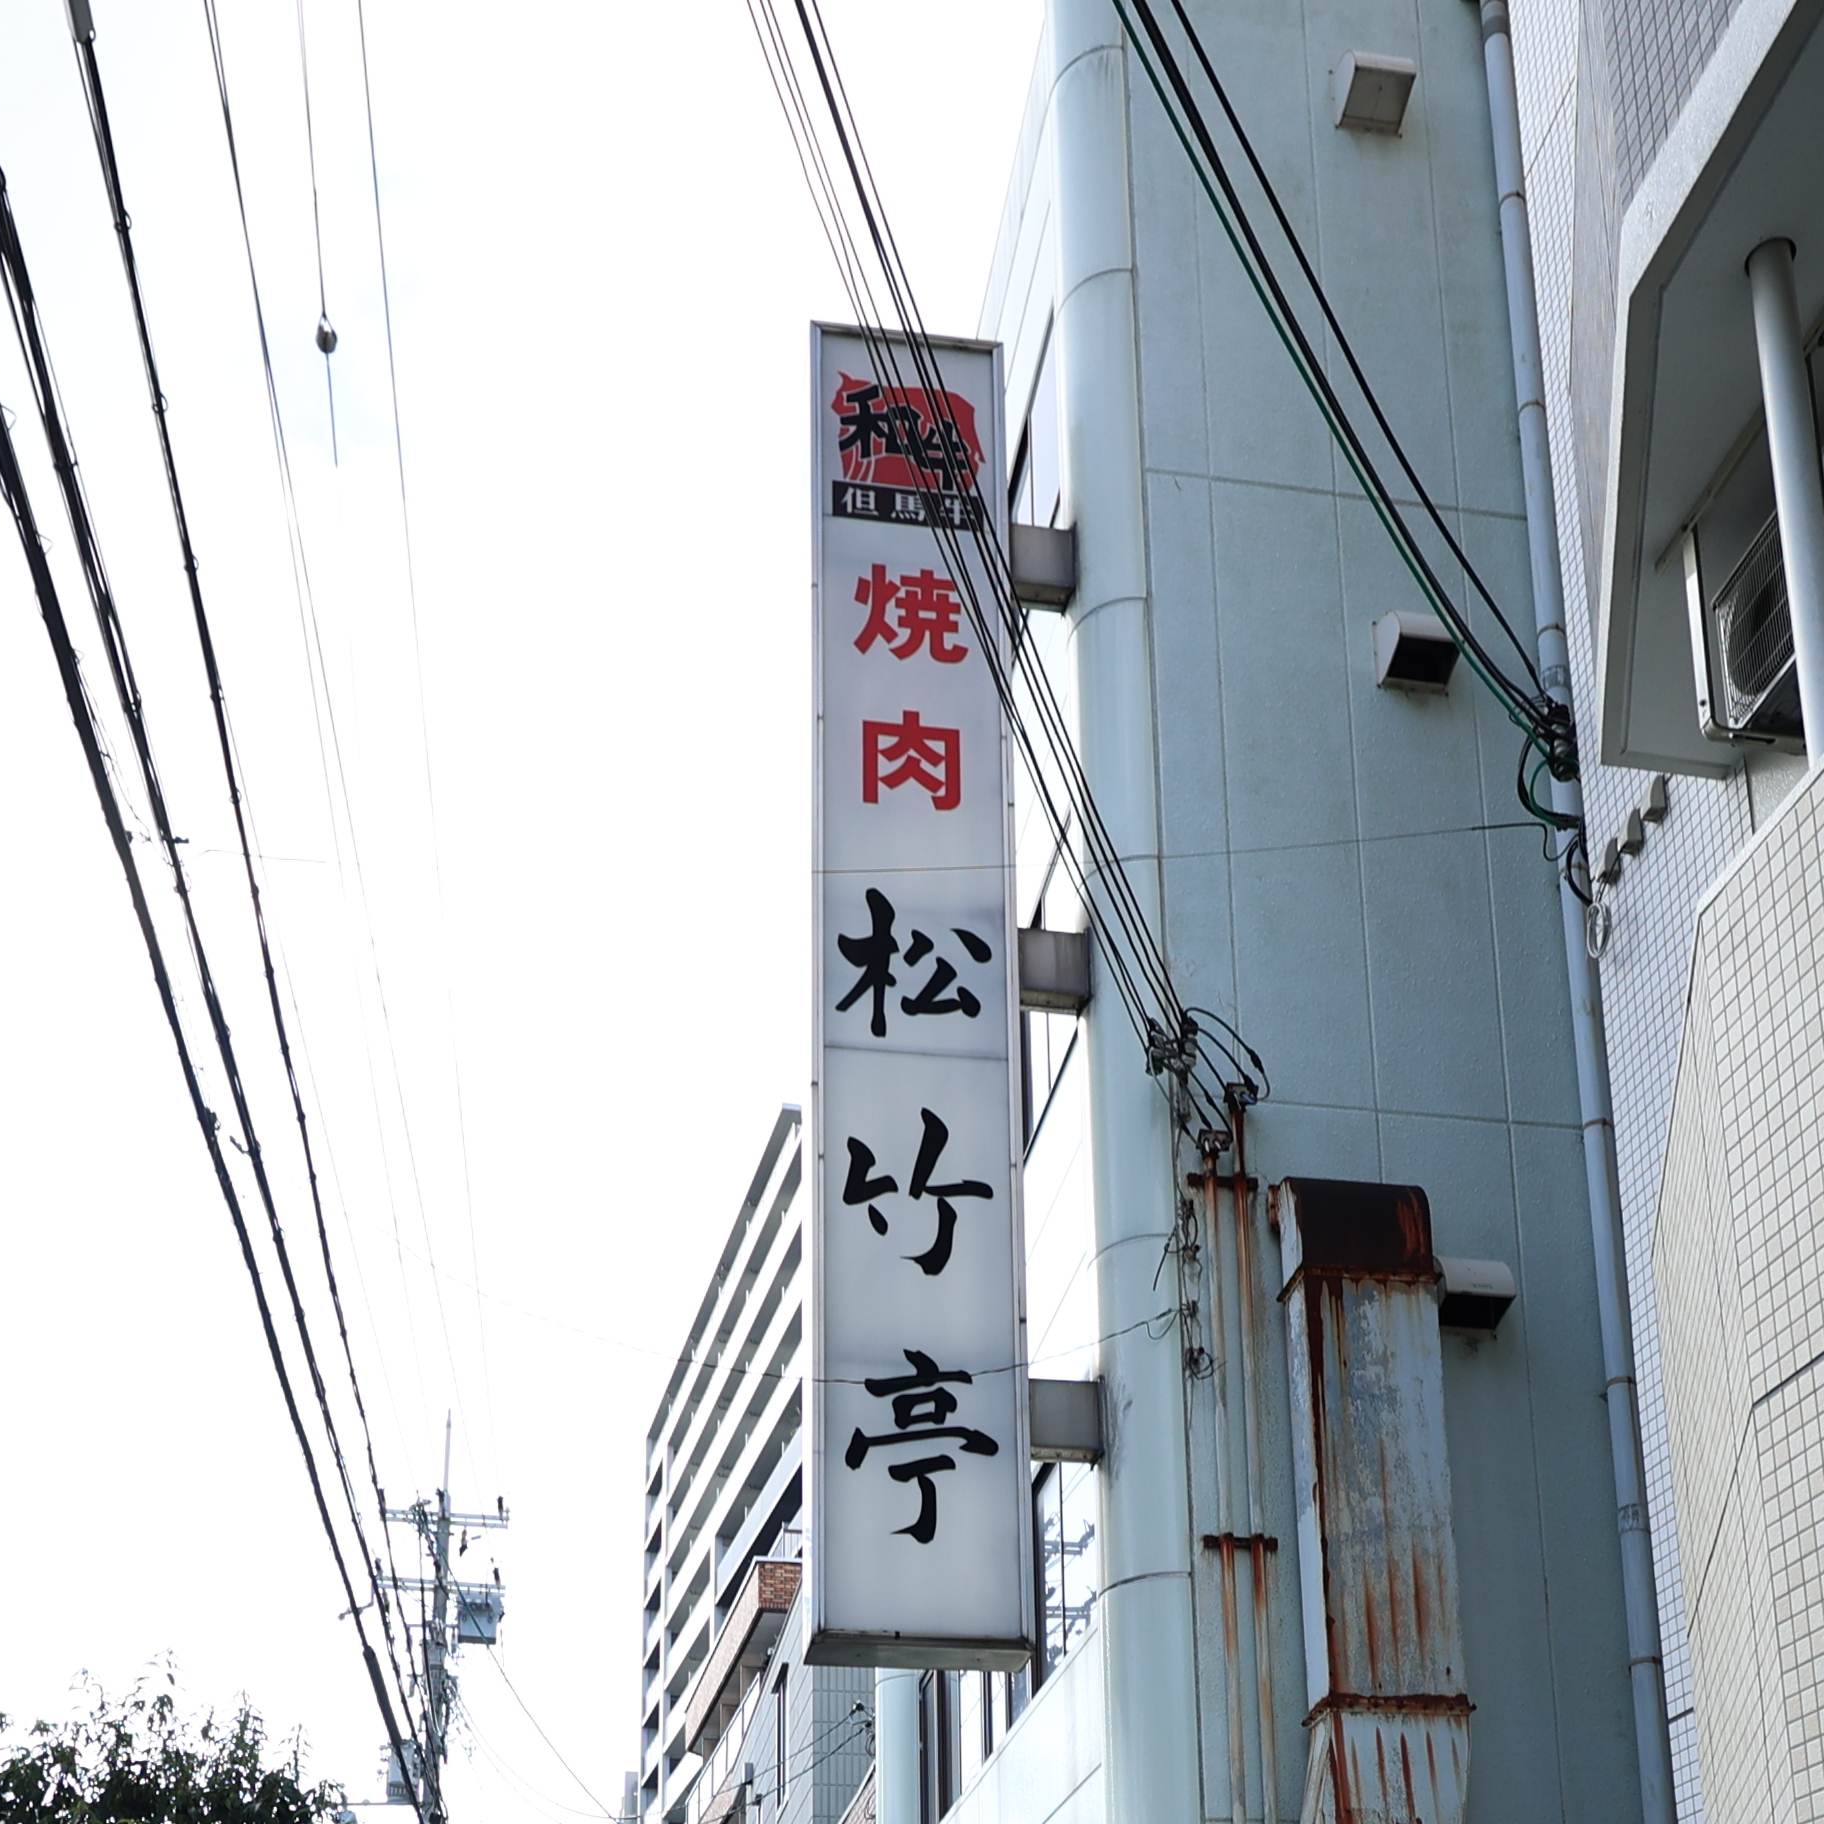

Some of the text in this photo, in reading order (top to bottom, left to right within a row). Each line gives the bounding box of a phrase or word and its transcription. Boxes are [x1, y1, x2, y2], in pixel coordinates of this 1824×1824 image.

[839, 383, 969, 491] 和牛
[841, 487, 976, 526] 但馬牛
[853, 562, 969, 811] 焼肉
[836, 887, 999, 1544] 松竹亭
